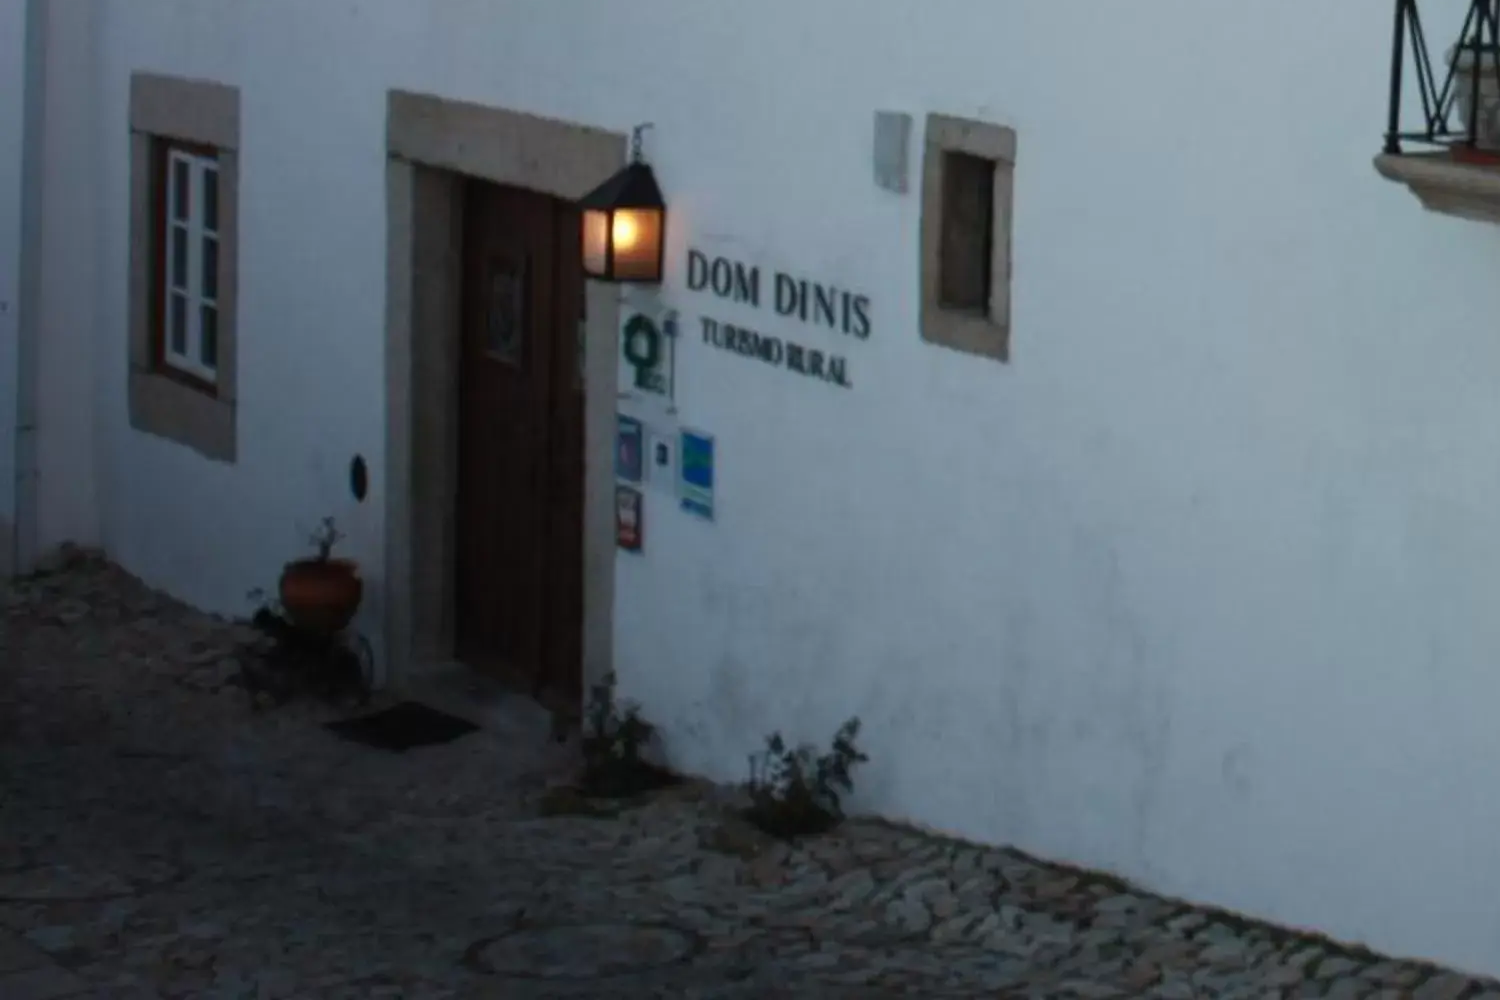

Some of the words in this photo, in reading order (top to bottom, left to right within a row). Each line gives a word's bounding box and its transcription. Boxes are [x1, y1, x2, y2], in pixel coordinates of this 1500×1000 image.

[687, 248, 760, 308] DOM
[773, 271, 871, 341] DINIS
[699, 315, 784, 368] TURISMO
[785, 340, 853, 390] RURAL
